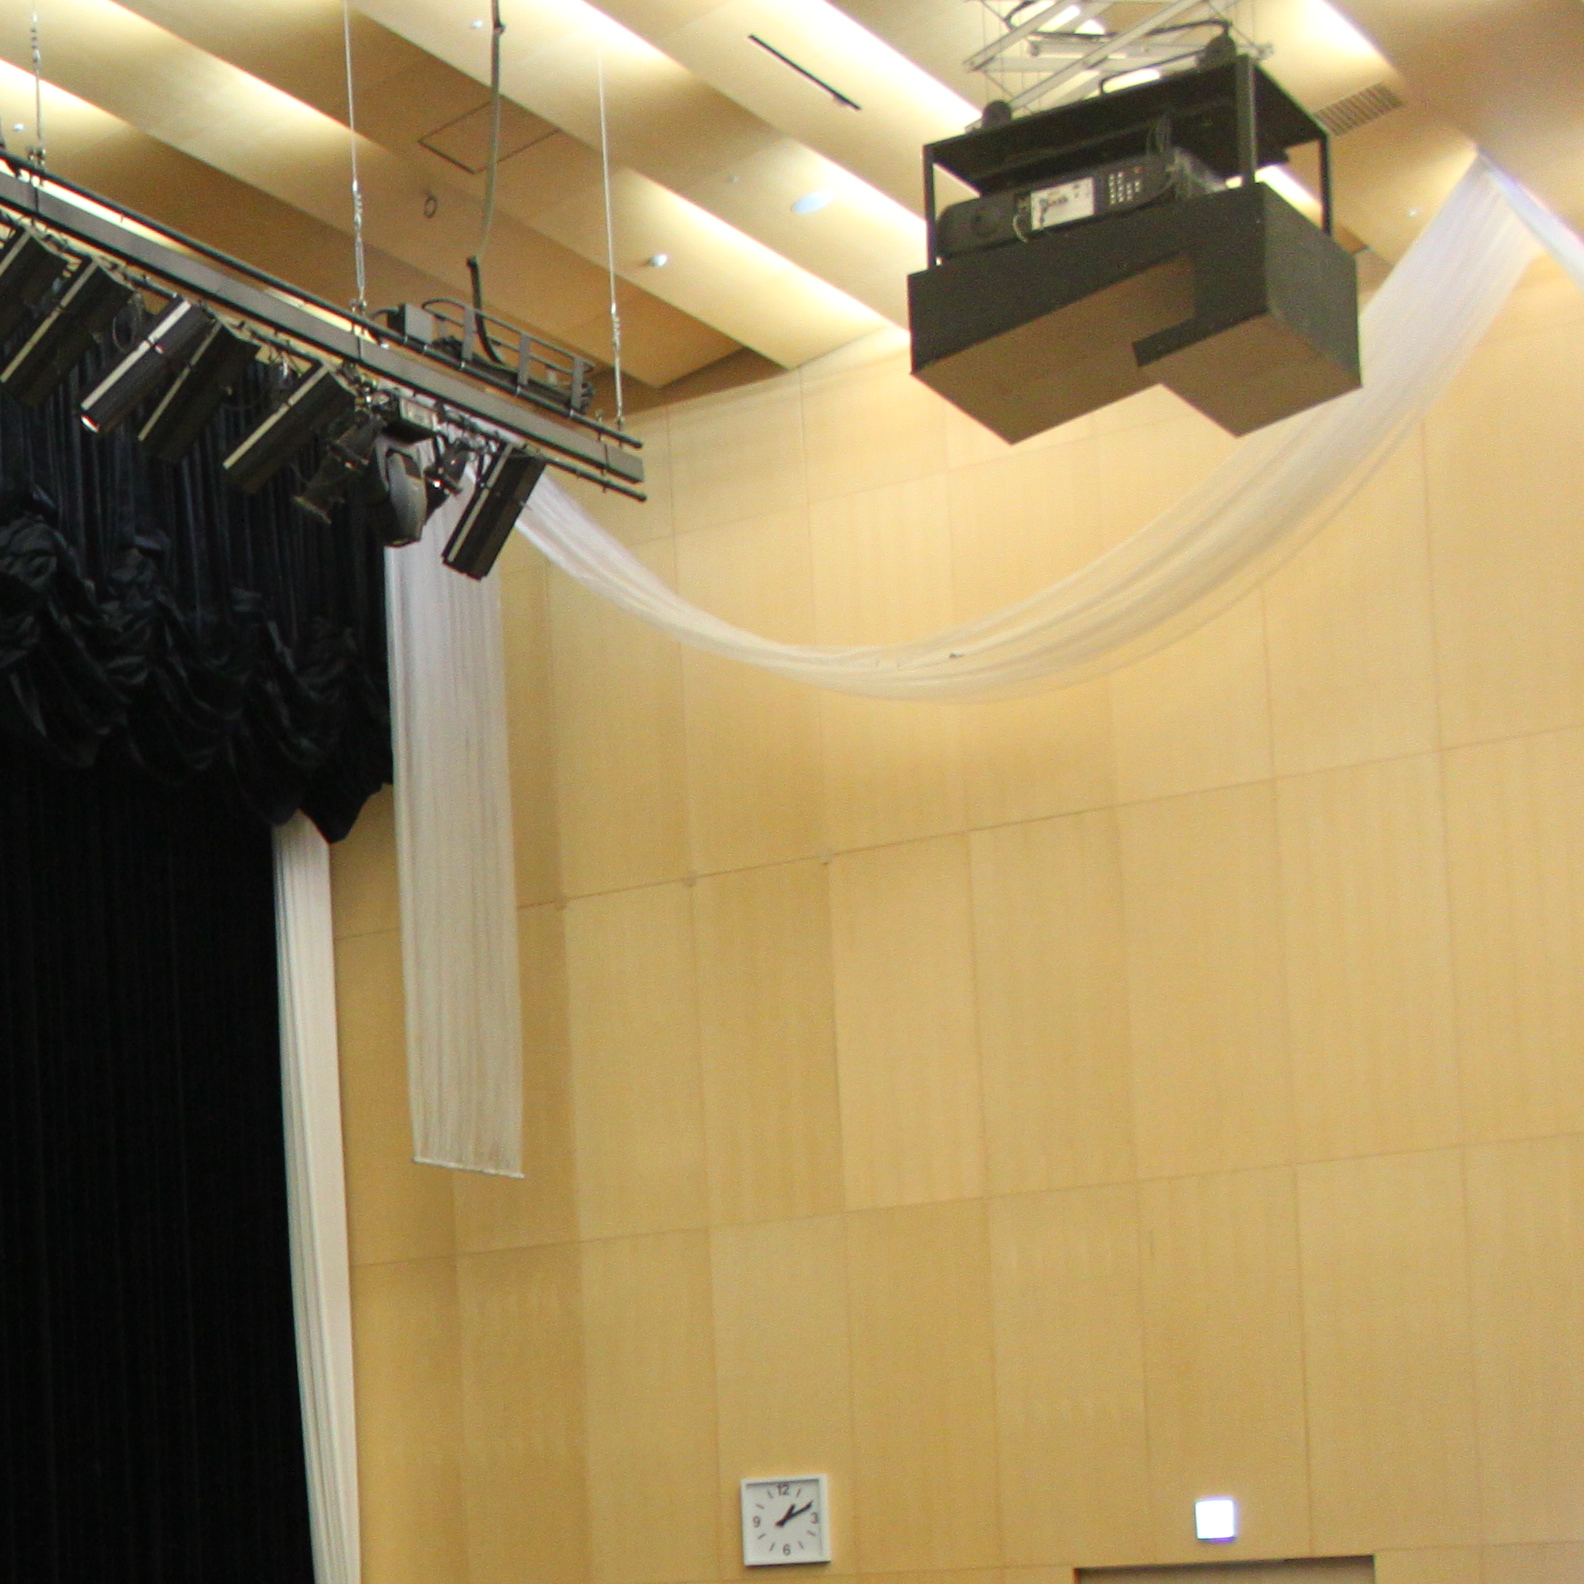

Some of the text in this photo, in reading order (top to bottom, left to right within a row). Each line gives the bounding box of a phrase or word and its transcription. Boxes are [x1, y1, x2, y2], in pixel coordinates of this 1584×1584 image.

[778, 1482, 789, 1496] 12
[753, 1516, 761, 1528] 9
[811, 1512, 818, 1525] 3
[782, 1544, 791, 1556] 6
